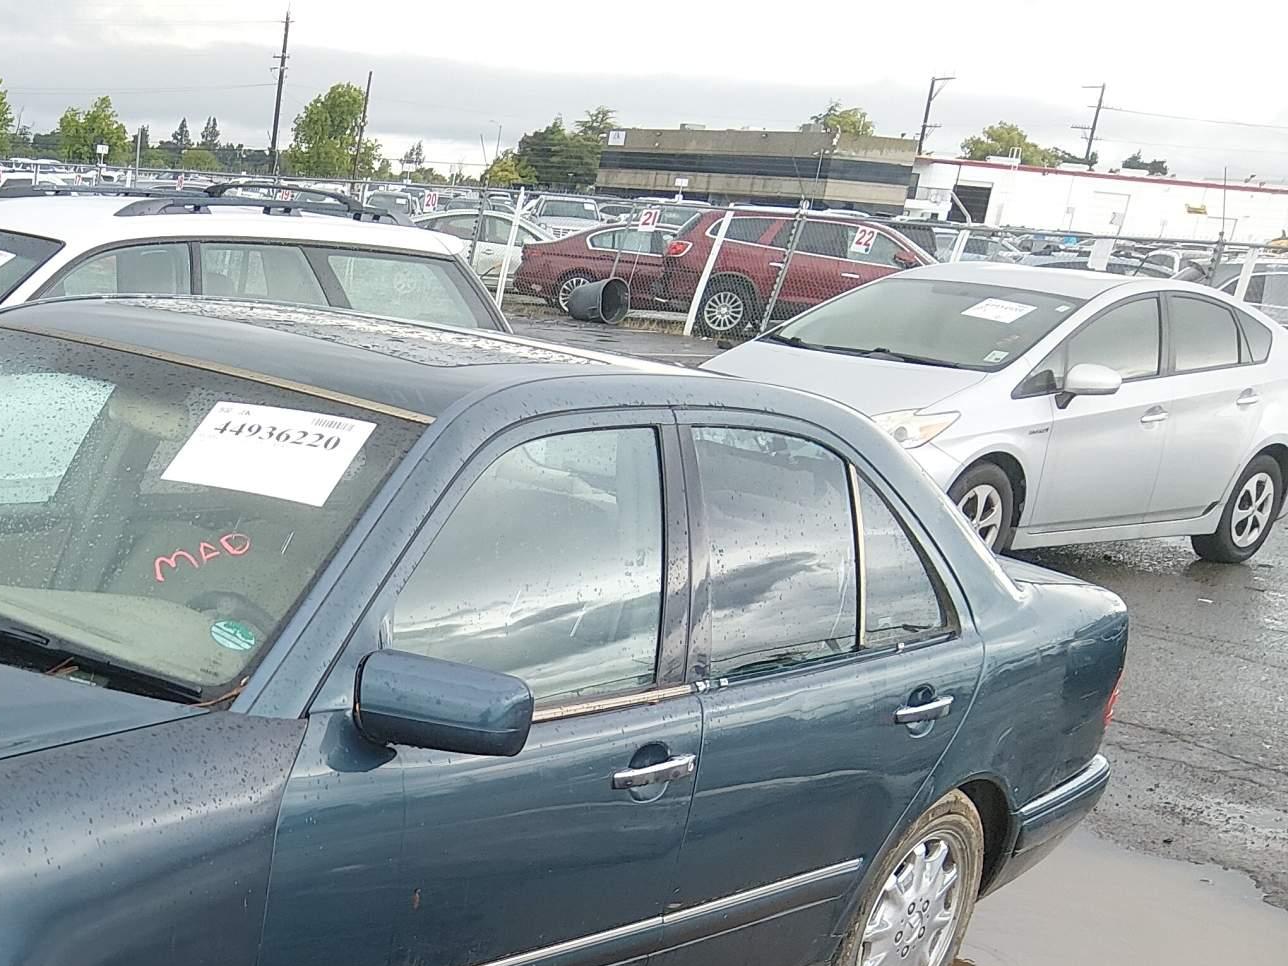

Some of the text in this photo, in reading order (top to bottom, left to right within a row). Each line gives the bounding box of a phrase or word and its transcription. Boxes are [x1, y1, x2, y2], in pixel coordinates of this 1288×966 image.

[425, 193, 437, 207] 20
[641, 211, 657, 225] 21
[855, 229, 875, 247] 22
[214, 420, 342, 450] 44936220
